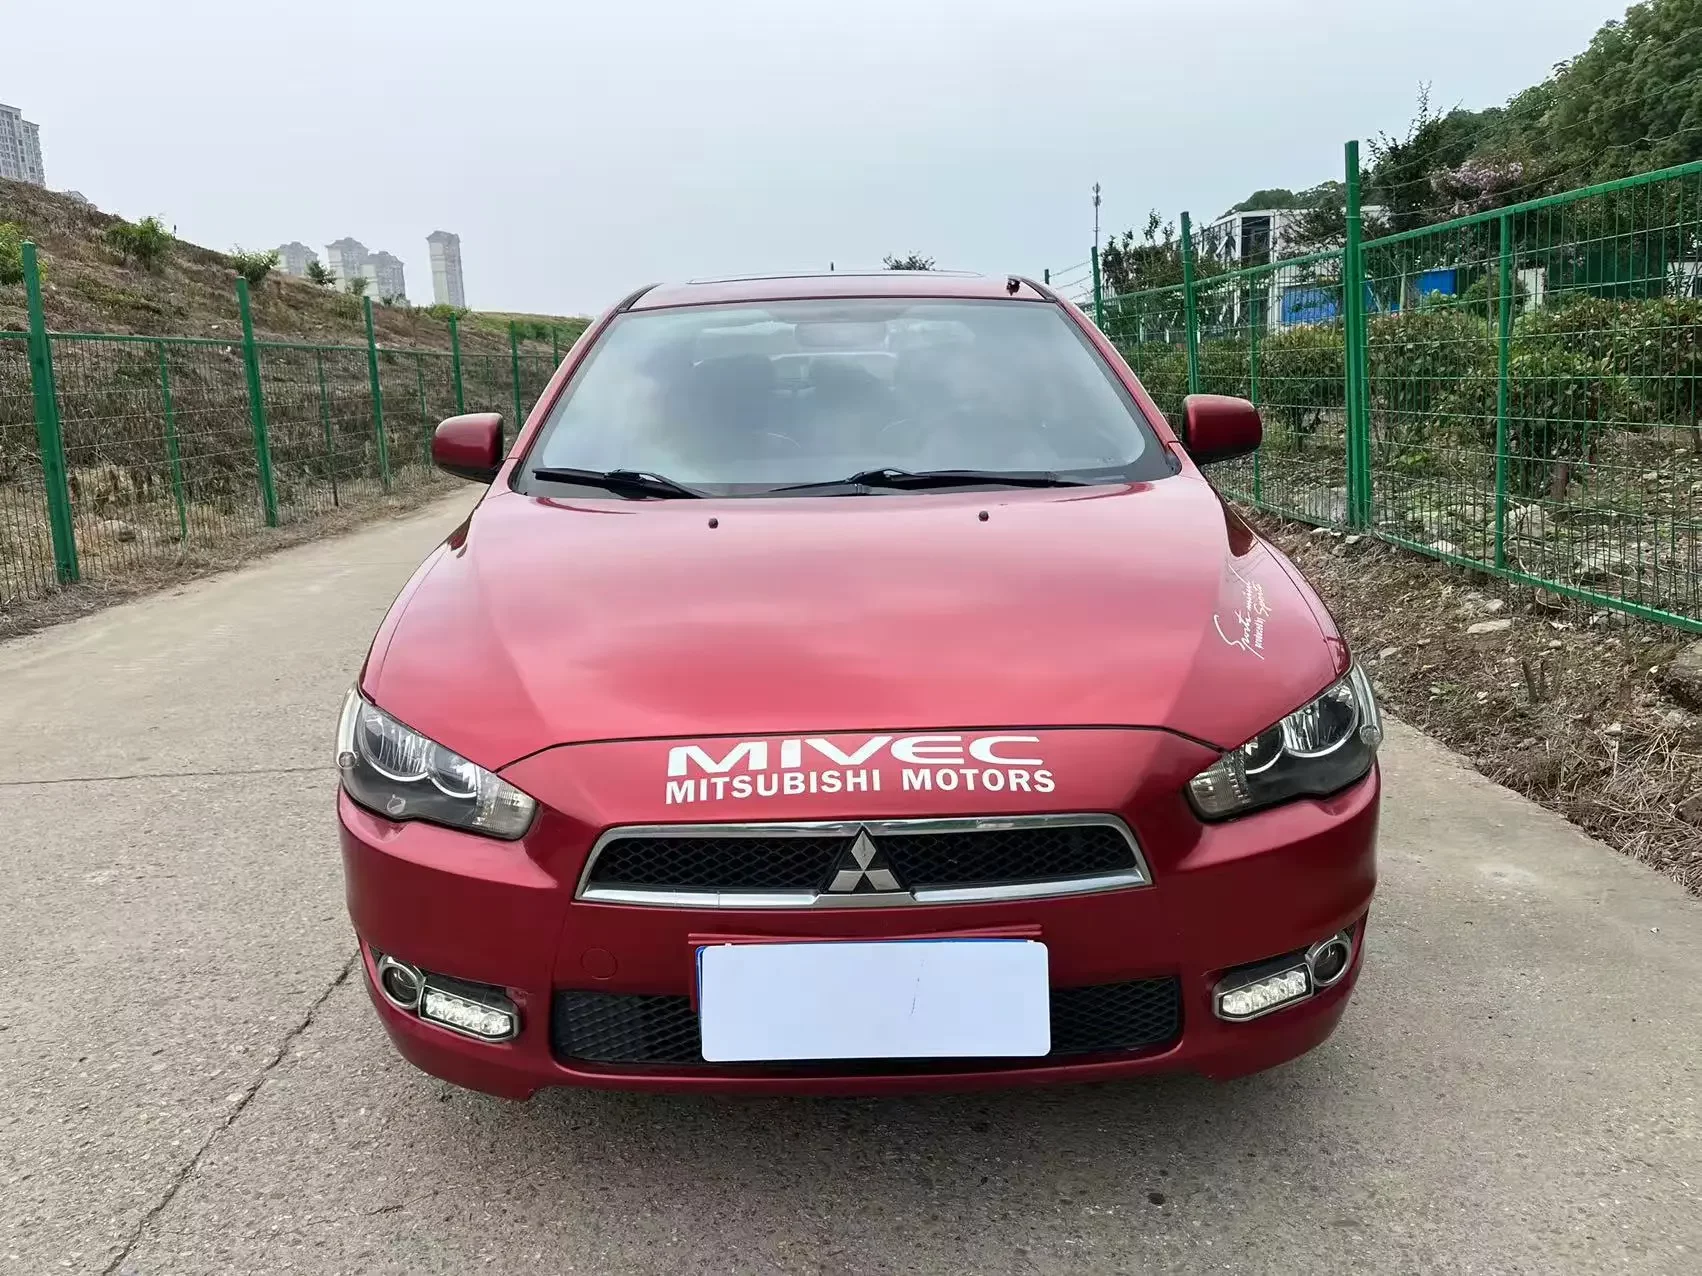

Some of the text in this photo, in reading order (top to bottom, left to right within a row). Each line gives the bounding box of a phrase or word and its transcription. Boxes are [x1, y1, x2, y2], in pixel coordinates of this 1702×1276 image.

[667, 735, 1045, 777] MIVEC
[665, 768, 1055, 804] MITSUBISHI MOTORS
